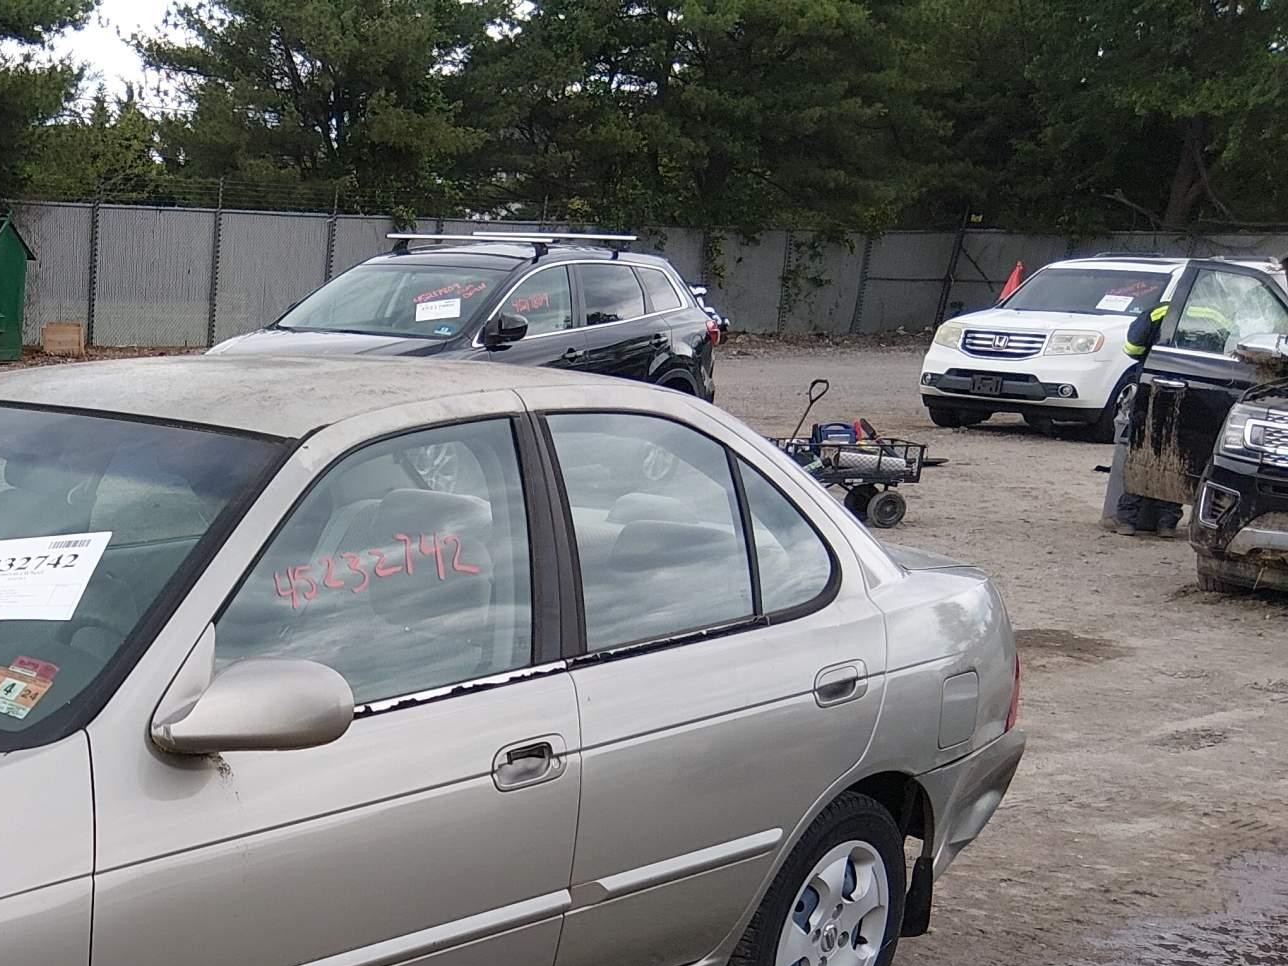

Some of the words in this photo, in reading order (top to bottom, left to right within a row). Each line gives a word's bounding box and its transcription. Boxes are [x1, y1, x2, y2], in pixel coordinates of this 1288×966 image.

[273, 532, 482, 609] 45232742
[3, 682, 17, 696] 4
[21, 689, 39, 700] 24
